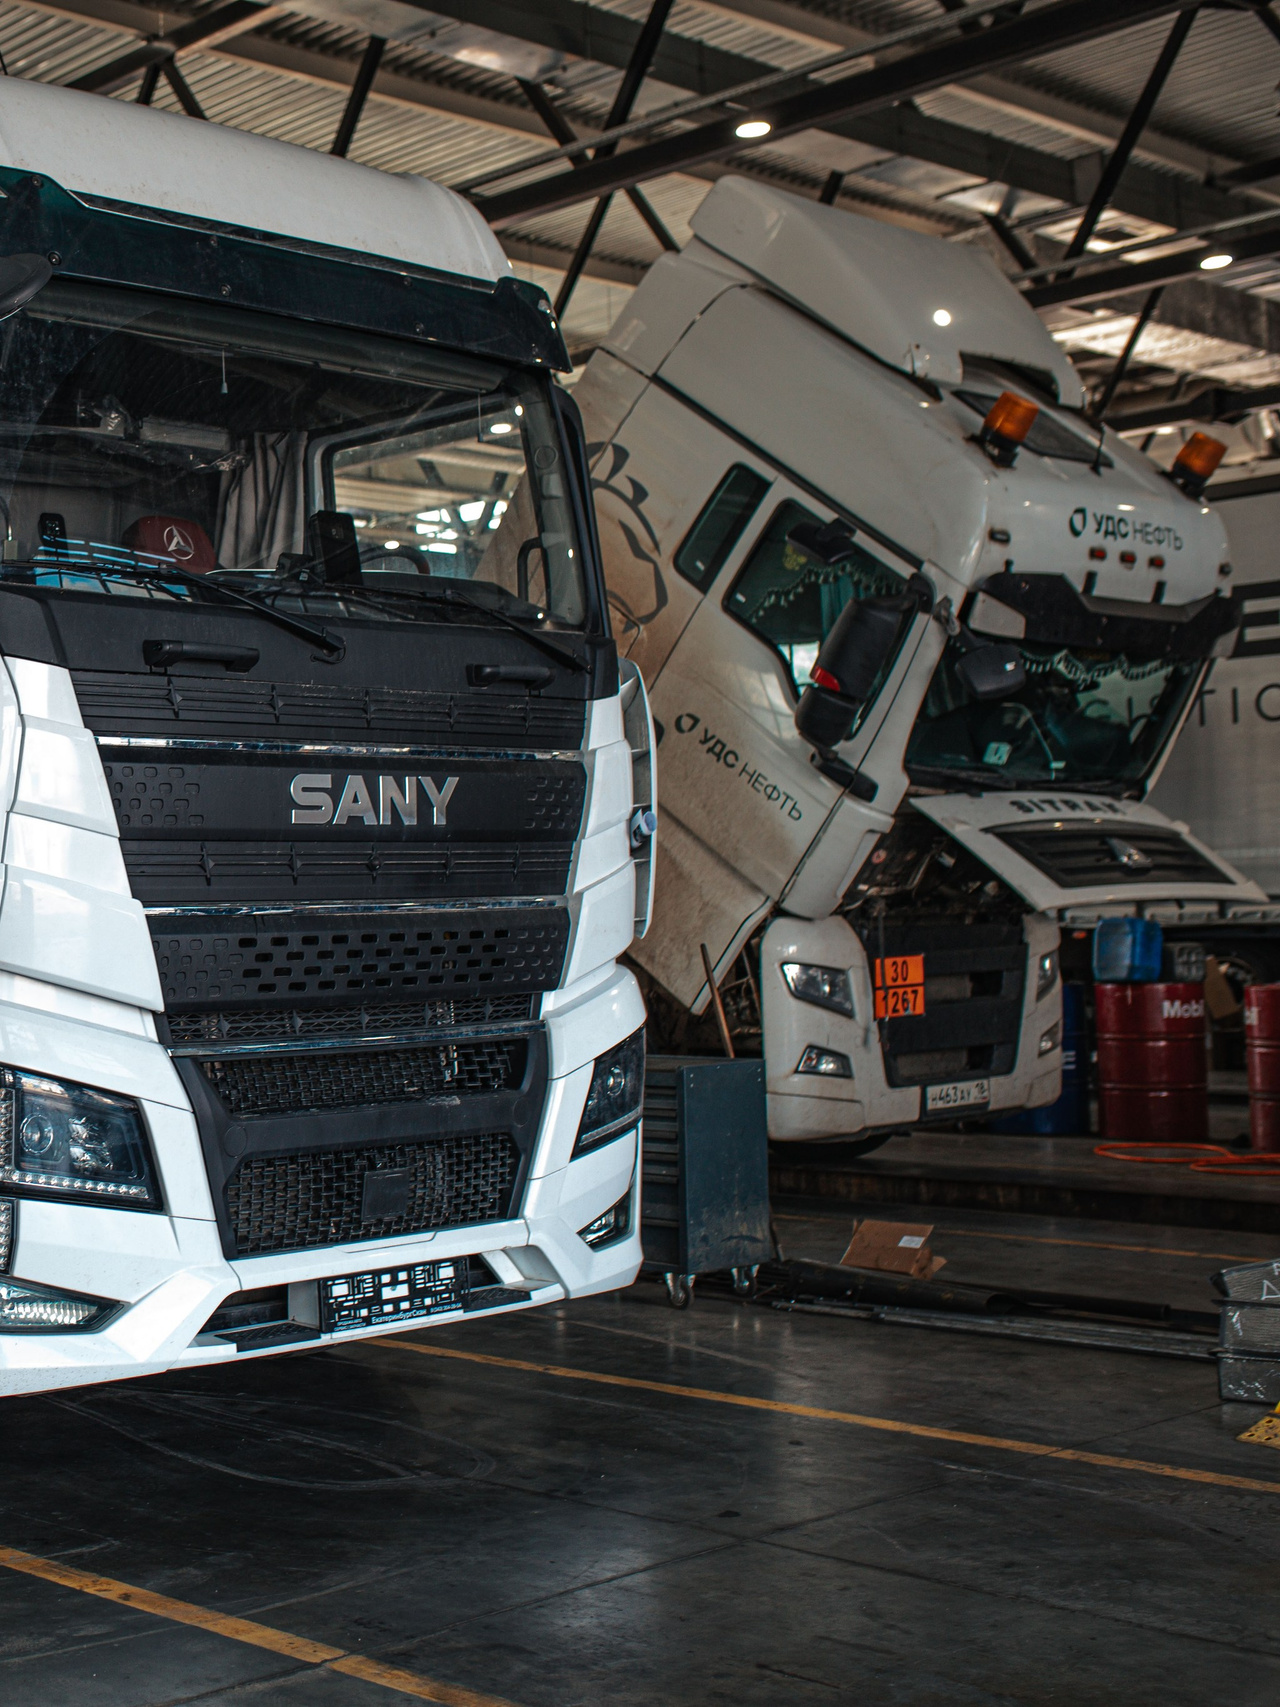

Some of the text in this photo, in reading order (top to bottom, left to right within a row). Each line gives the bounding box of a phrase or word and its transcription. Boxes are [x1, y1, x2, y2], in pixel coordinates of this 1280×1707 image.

[1093, 511, 1183, 551] УДС НЕФТЬ
[698, 726, 803, 822] УДС НЕФТЬ
[290, 773, 460, 826] SANY
[891, 960, 909, 983] 30
[882, 988, 919, 1014] 1267
